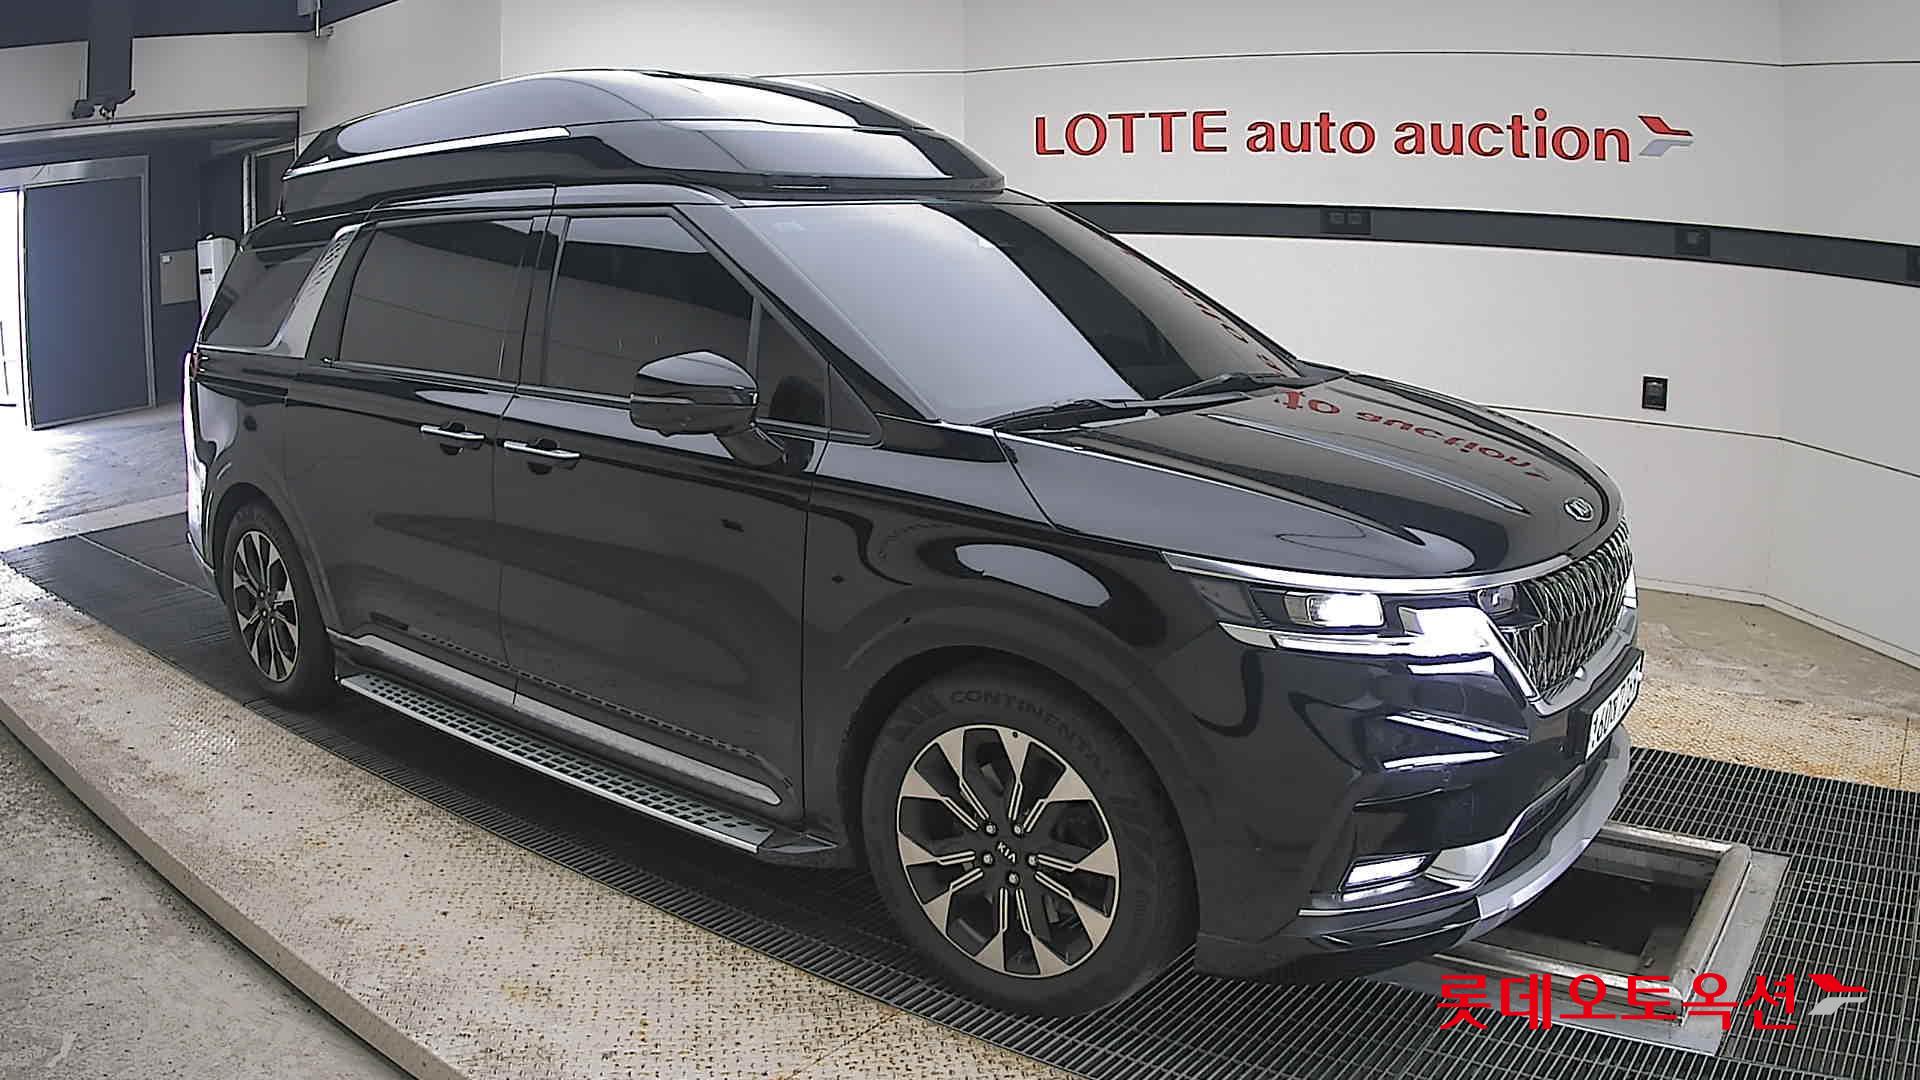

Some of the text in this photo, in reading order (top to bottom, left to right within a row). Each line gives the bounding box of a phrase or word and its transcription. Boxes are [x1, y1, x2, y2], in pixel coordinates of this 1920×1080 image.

[1034, 107, 1631, 162] LOTTE auto auction
[997, 841, 1016, 864] KIA
